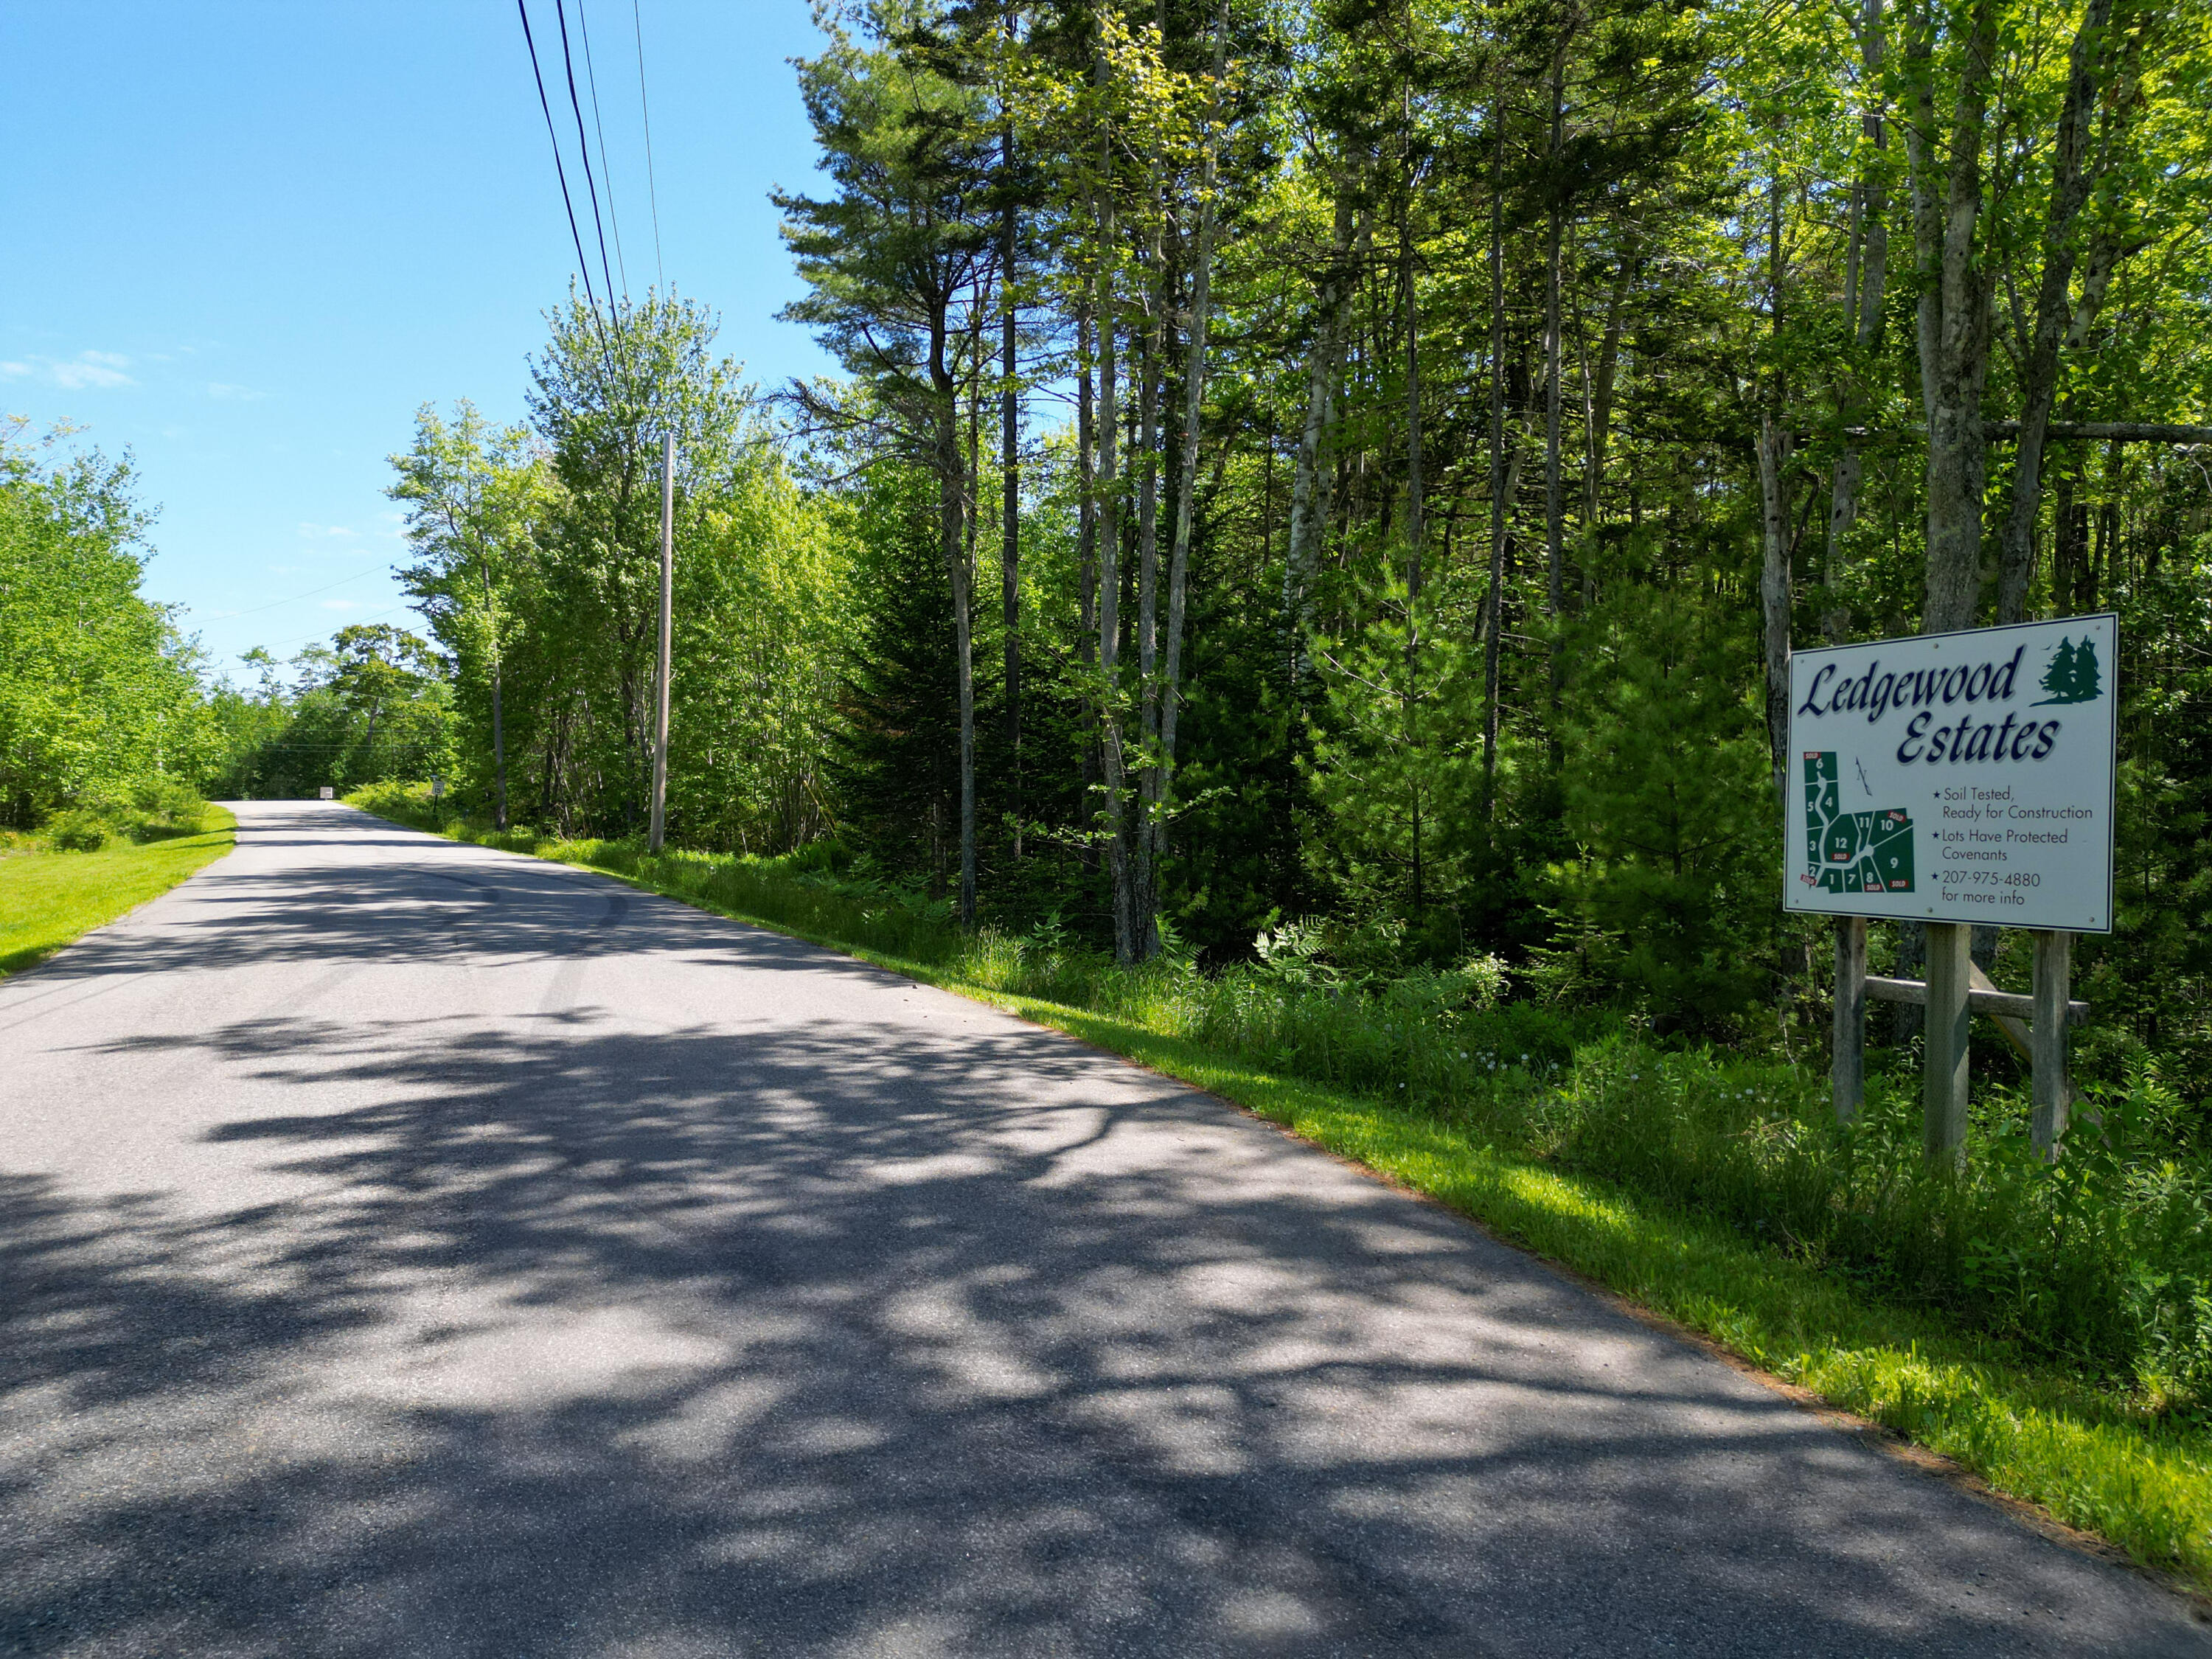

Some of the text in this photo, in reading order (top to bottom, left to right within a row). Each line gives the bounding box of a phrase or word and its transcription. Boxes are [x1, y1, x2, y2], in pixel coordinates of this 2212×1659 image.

[1797, 643, 2027, 724] Ledgewood
[1896, 710, 2063, 766] Estates
[1816, 758, 1823, 769] 6
[1944, 785, 2014, 802] Soil Tested,
[1807, 801, 1814, 812] 5
[1825, 797, 1832, 807] 4
[1889, 812, 1904, 822] SOLD
[1943, 804, 2093, 822] Ready for Construction
[1859, 817, 1870, 828] 11
[1880, 819, 1893, 831] 10
[1942, 828, 2068, 844] Lots Have Protected
[1809, 841, 1816, 851] 3
[1835, 838, 1848, 849] 12
[1942, 846, 2007, 861] Covenants
[1890, 858, 1899, 869] 9
[1809, 866, 1816, 877] 2
[1801, 874, 1815, 885] SOLD
[1829, 874, 1834, 884] 1
[1848, 874, 1856, 884] 7
[1865, 872, 1874, 883] 8
[1942, 871, 2040, 887] 207-975-4880
[1941, 886, 2025, 905] for more info
